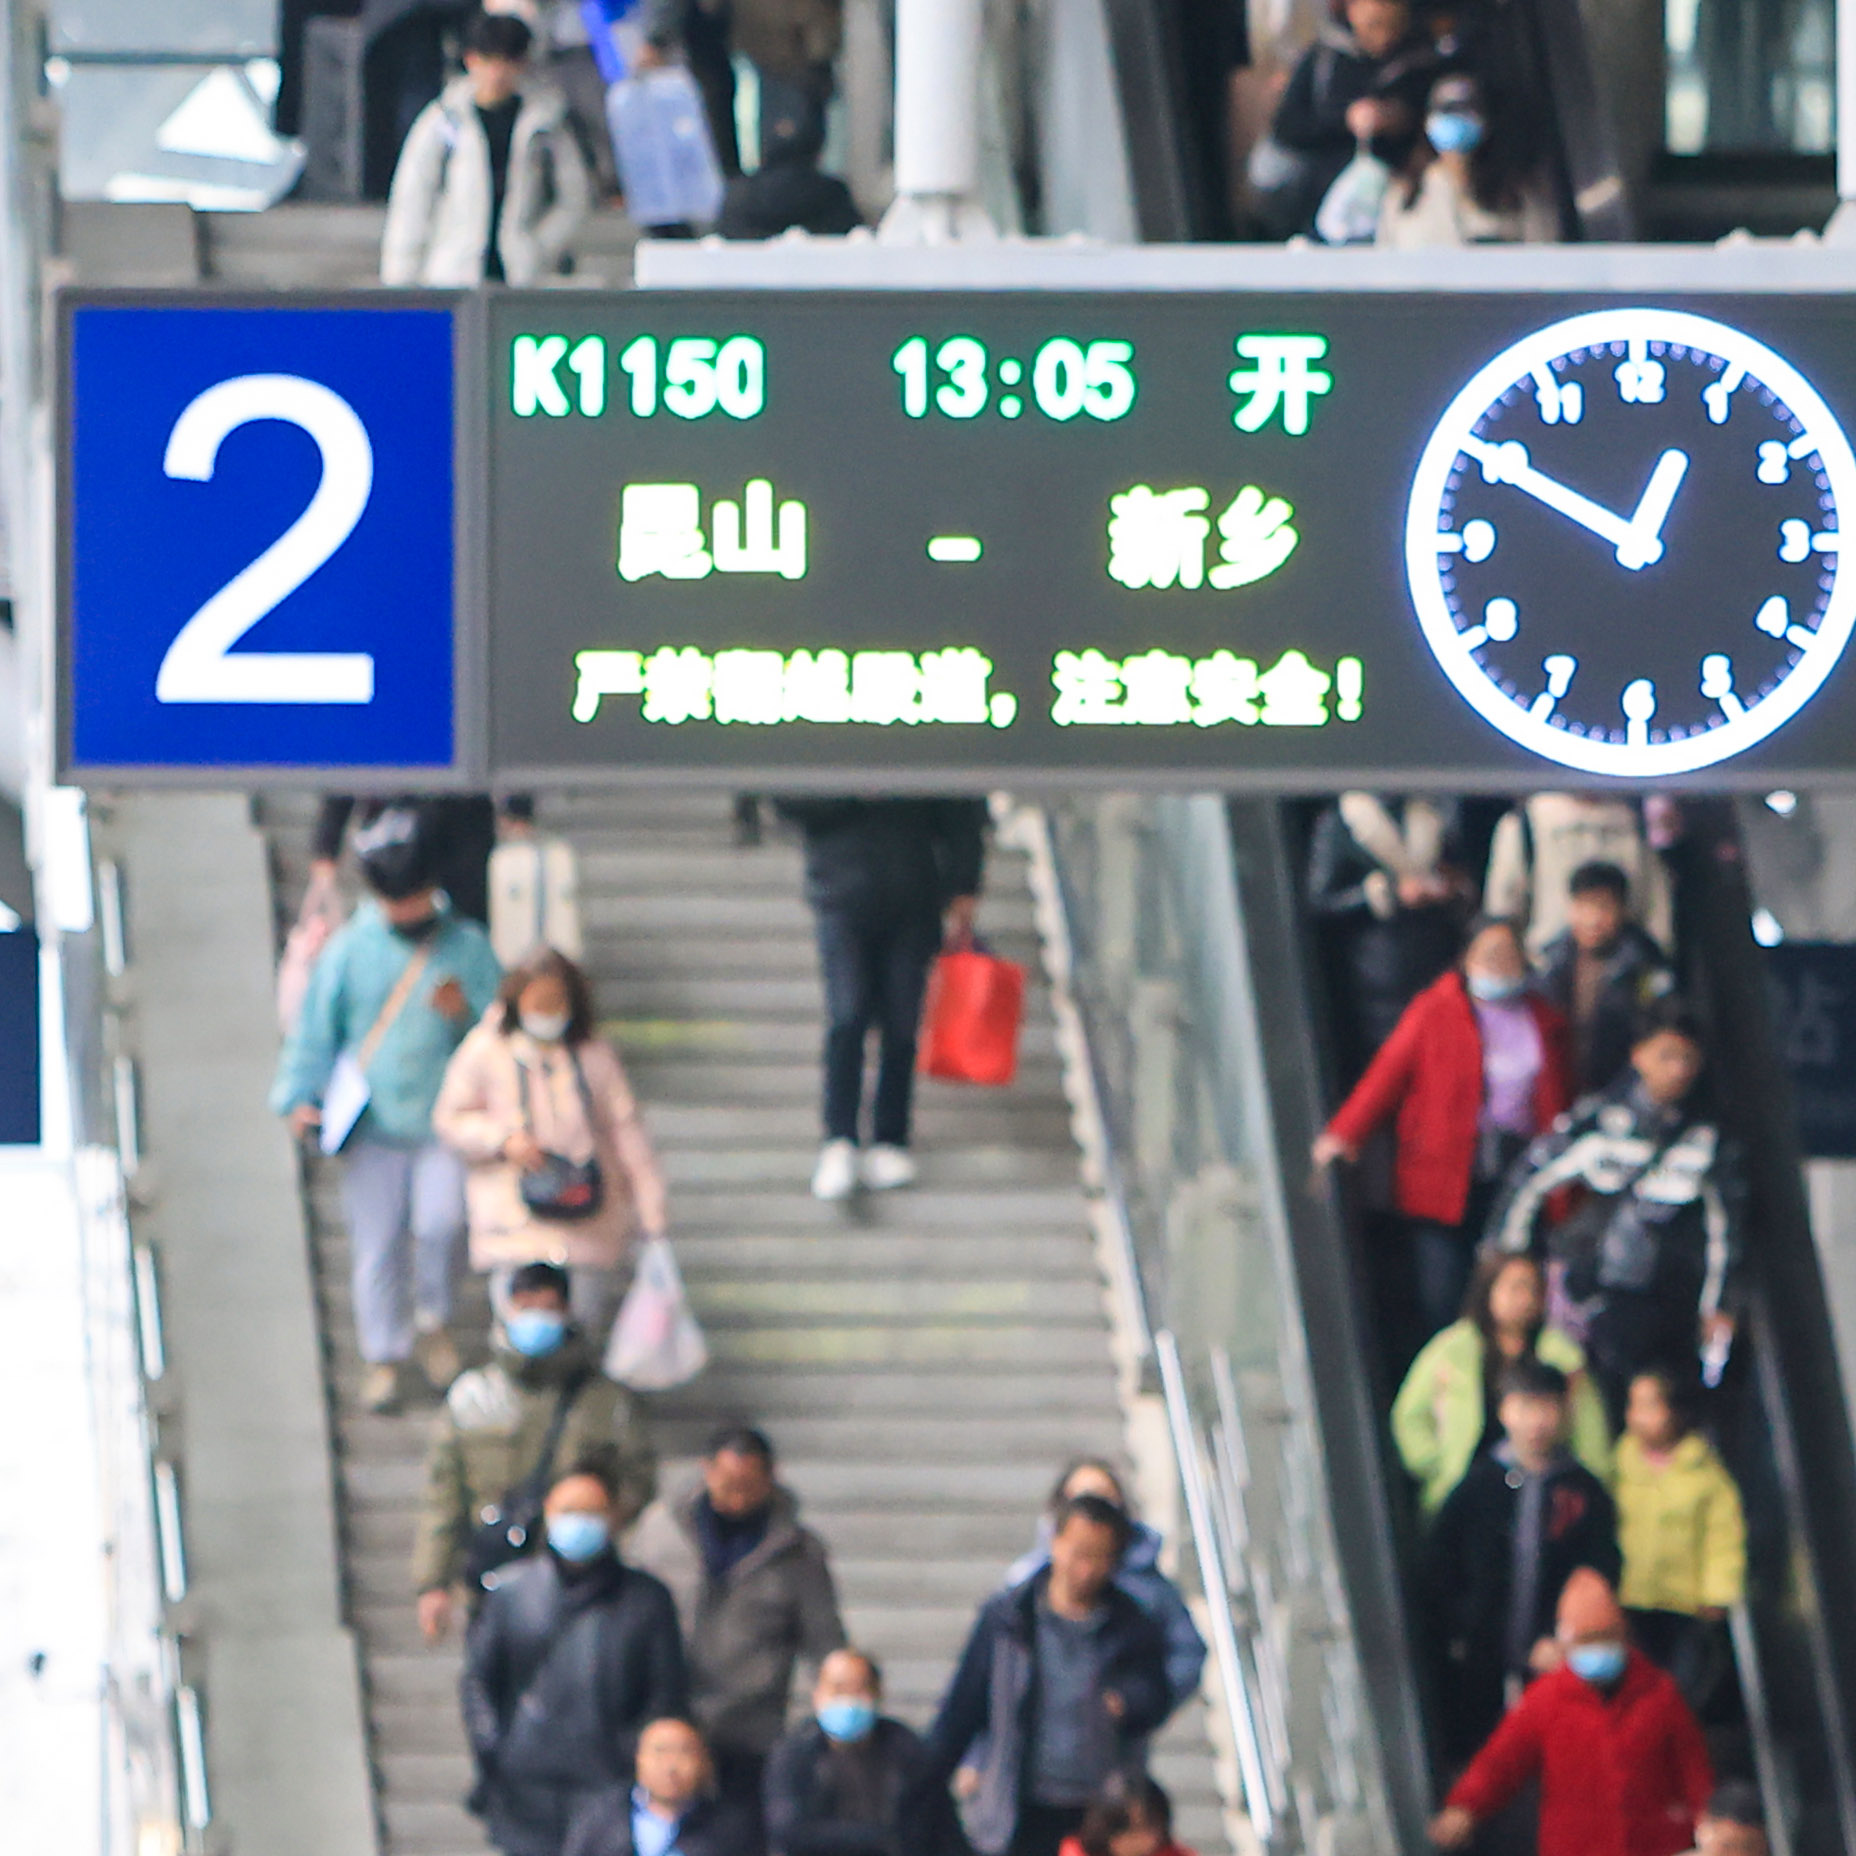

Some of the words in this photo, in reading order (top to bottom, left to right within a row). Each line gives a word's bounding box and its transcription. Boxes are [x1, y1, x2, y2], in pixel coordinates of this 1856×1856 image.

[511, 334, 765, 421] K1150
[892, 334, 1137, 423] 13:05
[1227, 332, 1334, 437] 开
[1535, 381, 1584, 425] 11
[1614, 359, 1666, 404] 12
[1702, 381, 1729, 425] 1
[1756, 439, 1790, 485] 2
[156, 374, 374, 704] 2
[616, 477, 808, 583] 昆山
[1106, 482, 1300, 591] 新乡
[1462, 517, 1497, 564] 9
[1777, 517, 1812, 564] 3
[1484, 597, 1519, 643] 8
[1754, 594, 1789, 639] 4
[1542, 653, 1578, 699] 7
[1700, 653, 1733, 699] 5
[1621, 678, 1657, 724] 6
